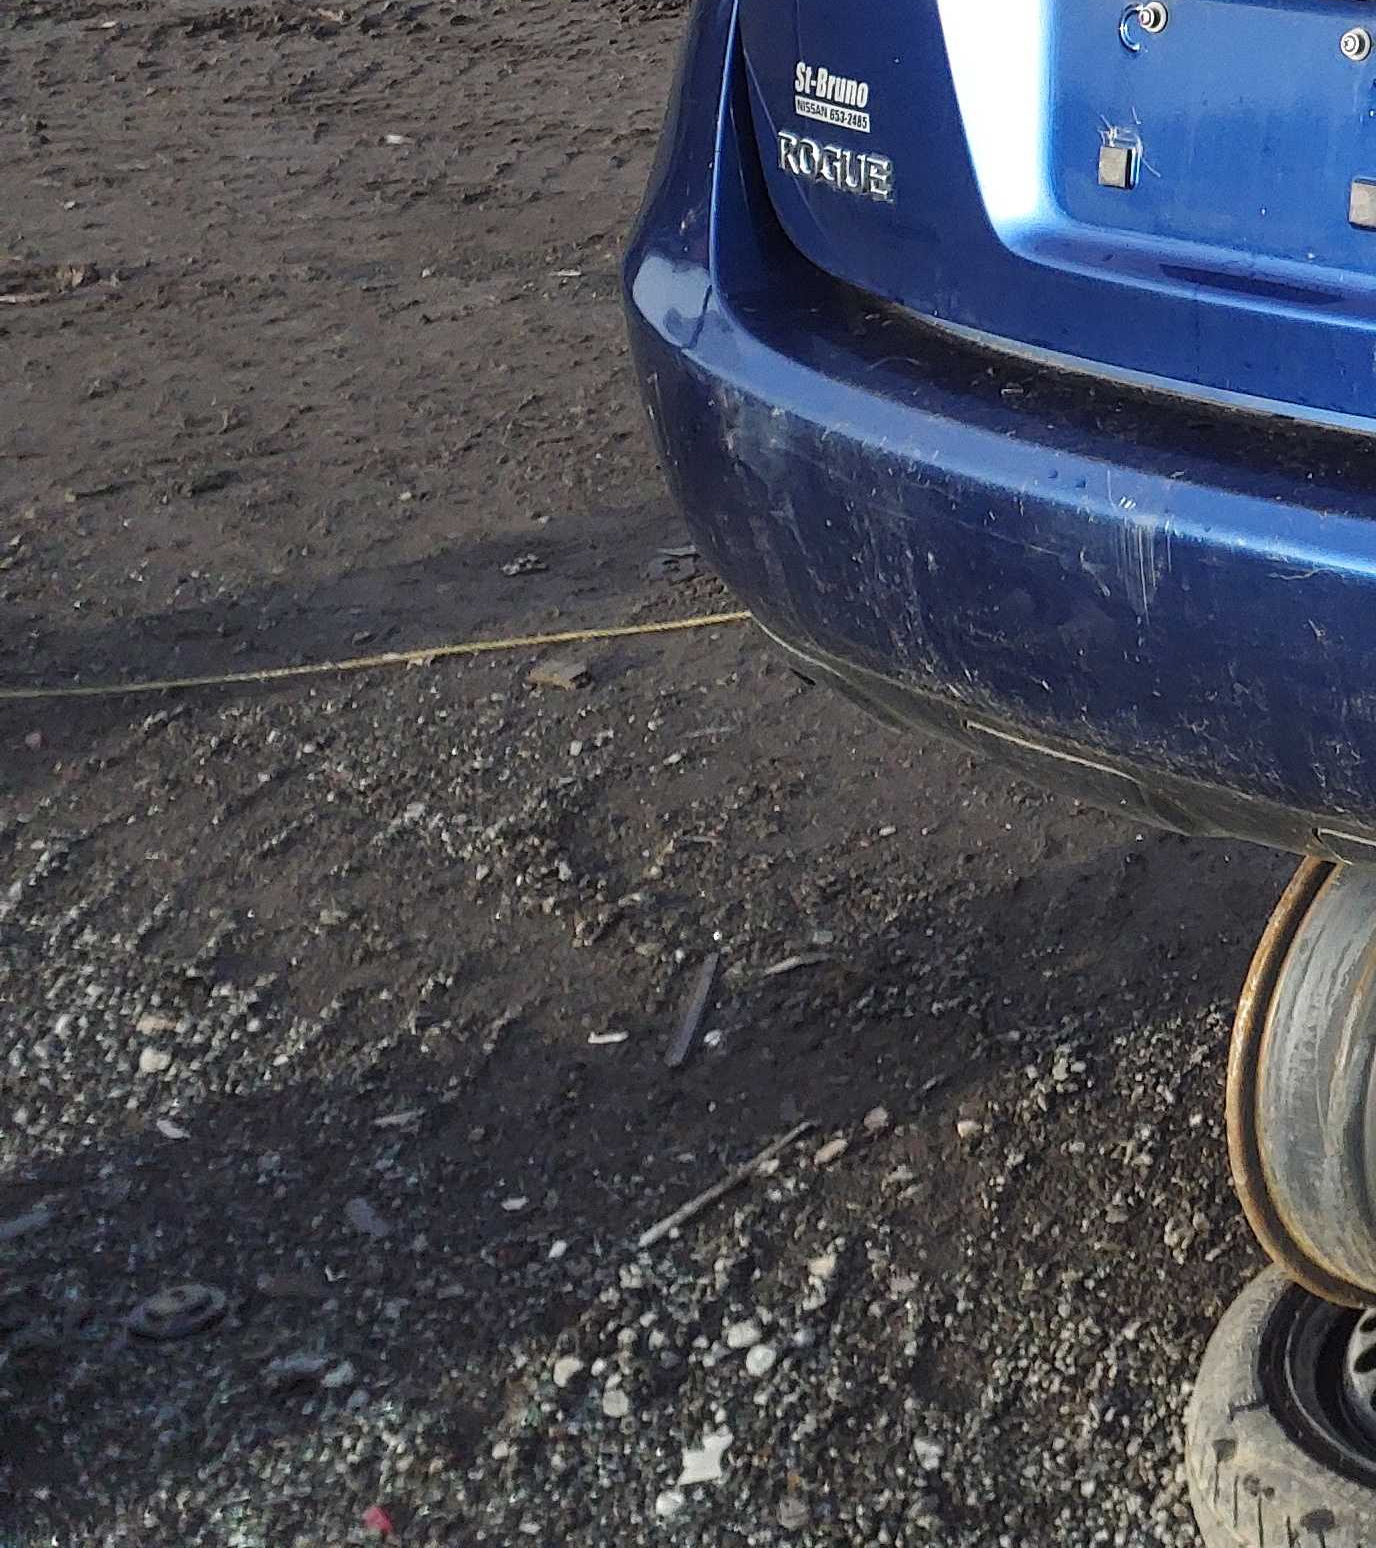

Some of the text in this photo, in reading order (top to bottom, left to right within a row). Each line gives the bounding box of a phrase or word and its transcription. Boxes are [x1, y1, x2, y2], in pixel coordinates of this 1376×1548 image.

[794, 61, 869, 108] St-Bruno
[797, 99, 828, 118] NISSAN
[777, 131, 894, 203] ROGUE
